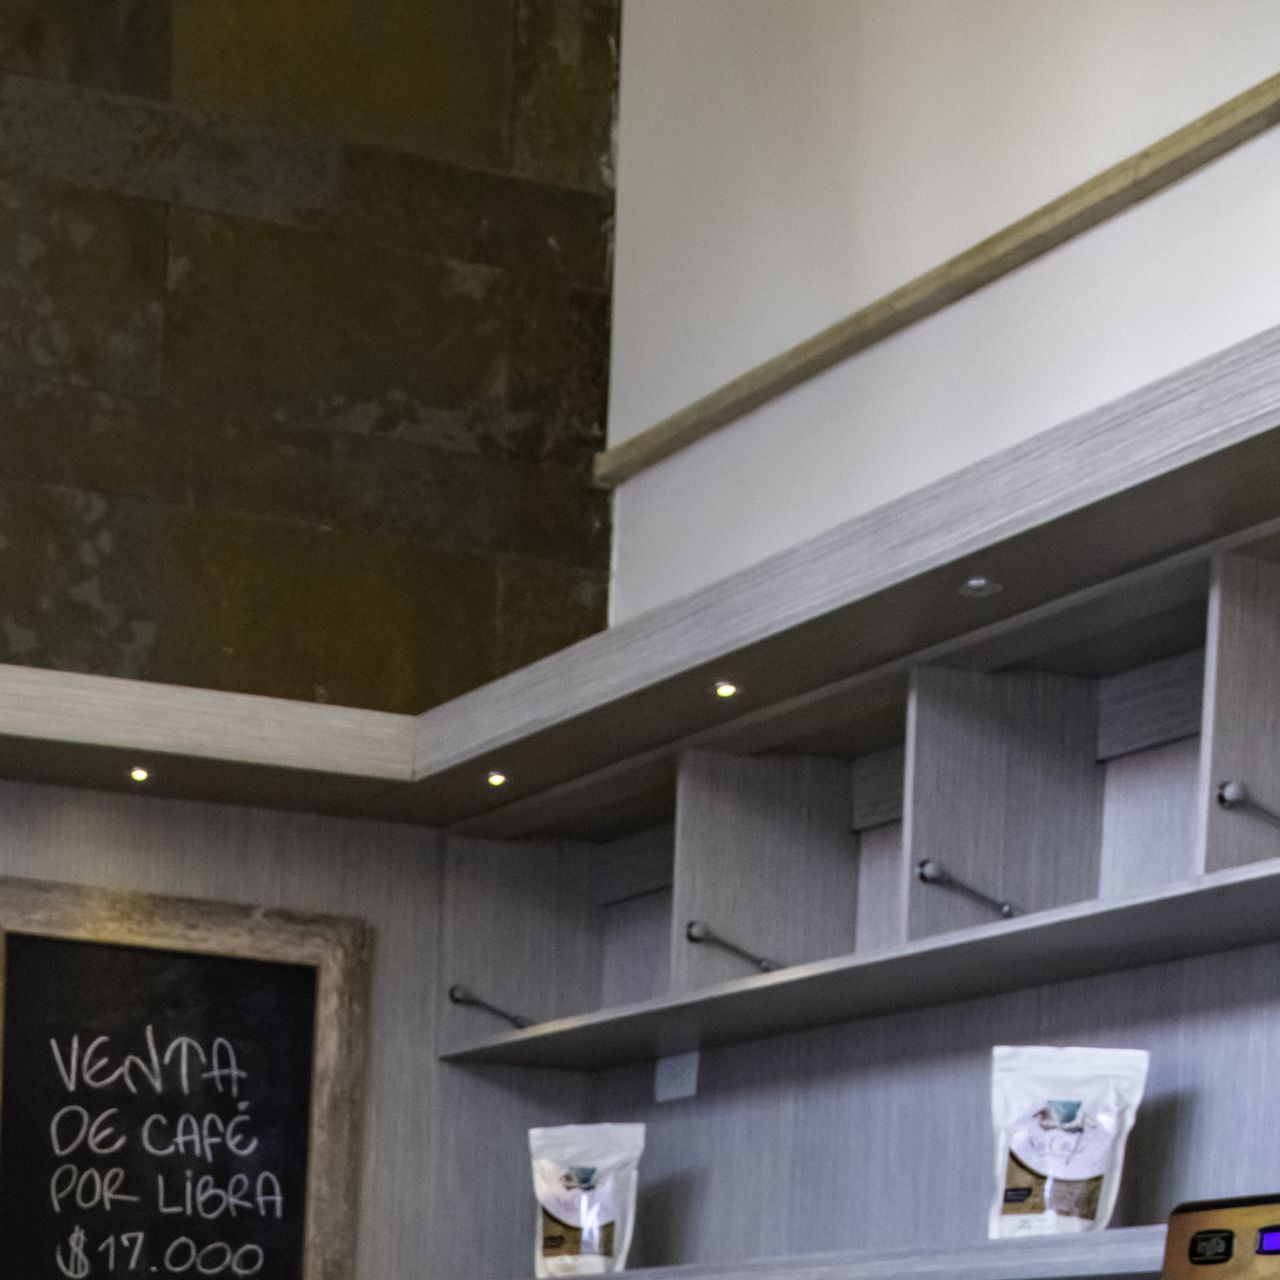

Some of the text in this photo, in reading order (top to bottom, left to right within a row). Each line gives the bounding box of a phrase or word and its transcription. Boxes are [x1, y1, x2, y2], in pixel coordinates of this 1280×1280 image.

[50, 1024, 248, 1097] VENTA
[50, 1101, 258, 1163] DE CAFÉ
[50, 1164, 141, 1213] POR
